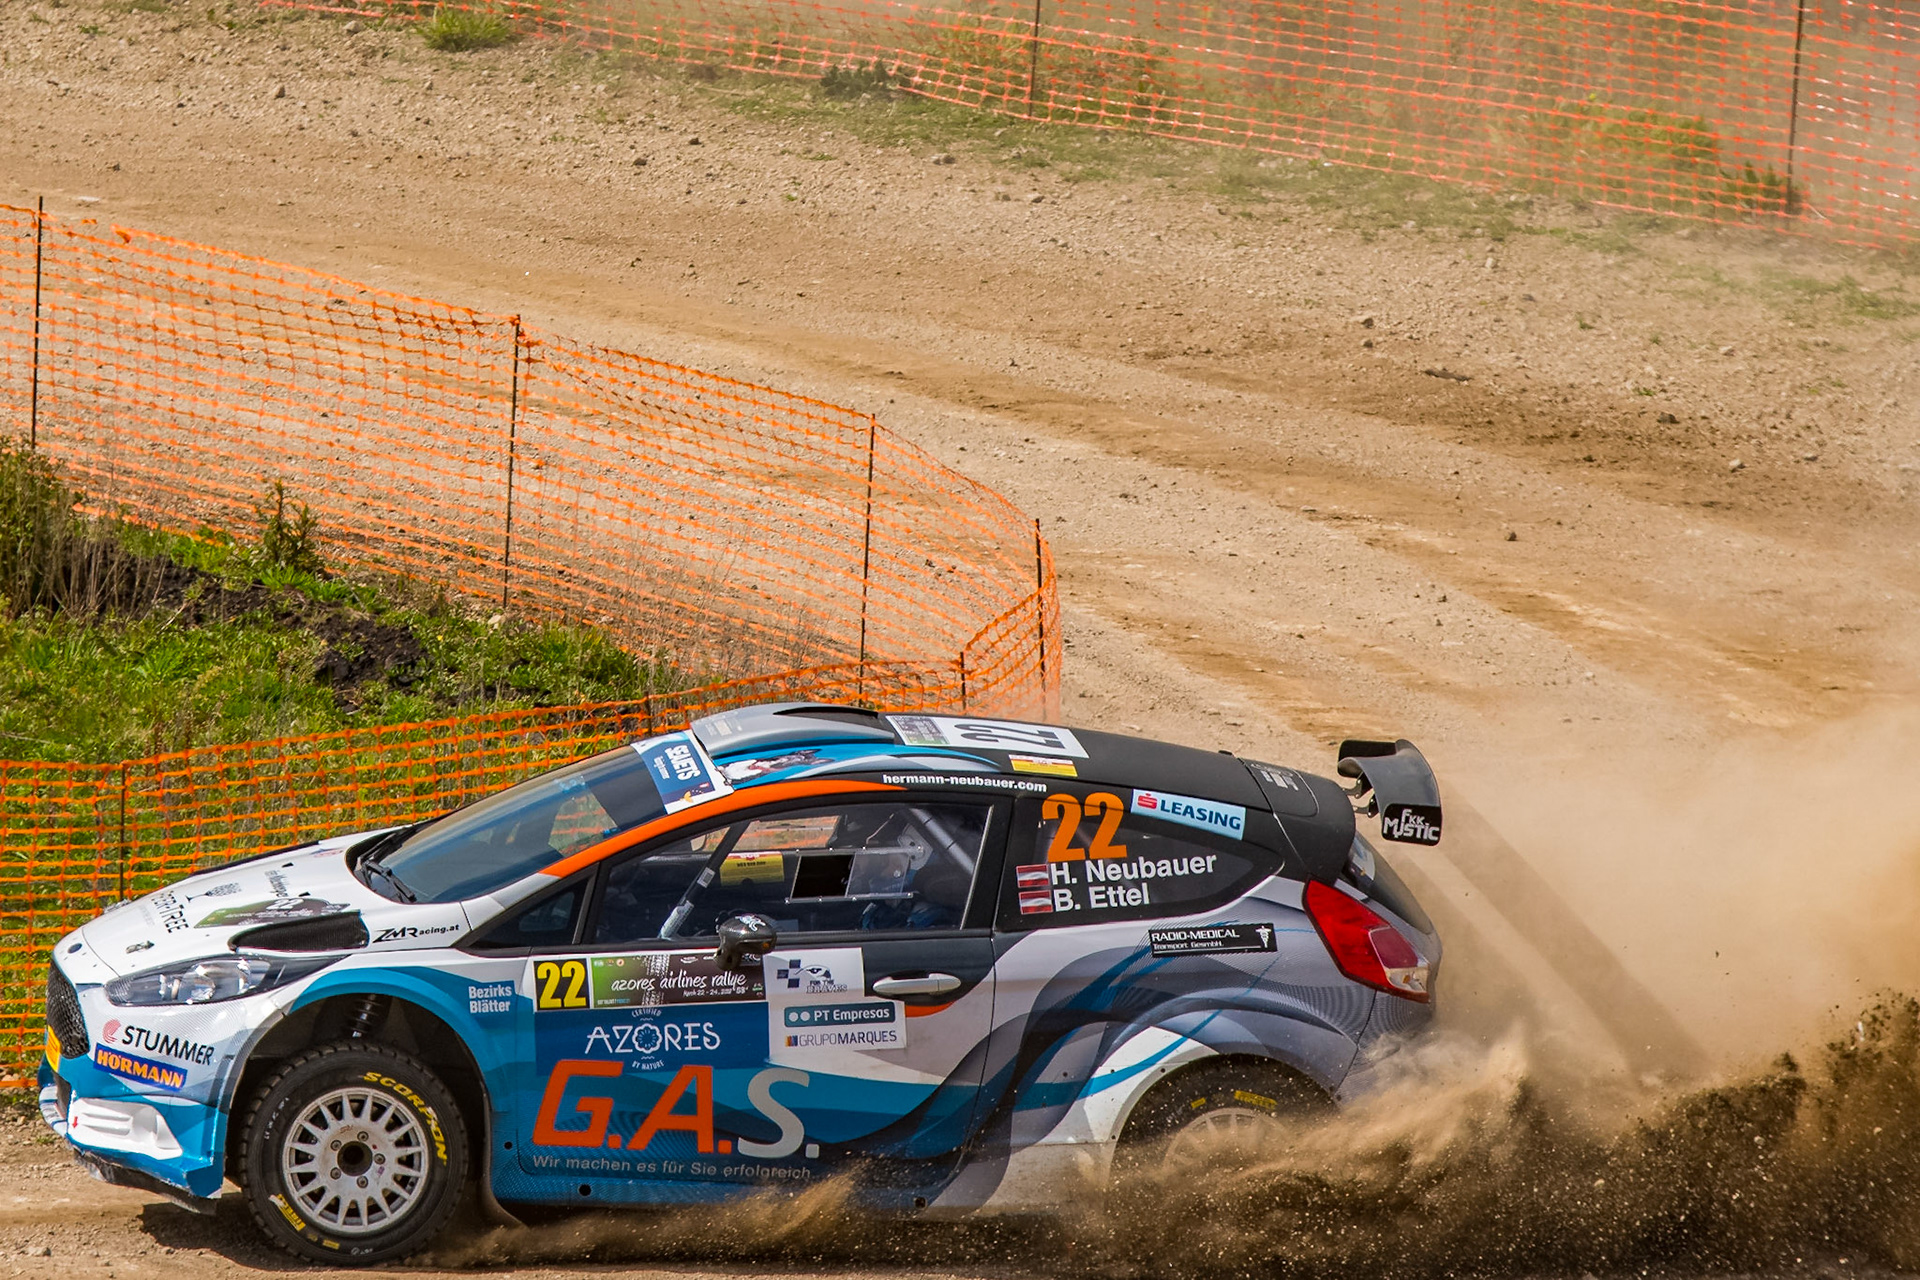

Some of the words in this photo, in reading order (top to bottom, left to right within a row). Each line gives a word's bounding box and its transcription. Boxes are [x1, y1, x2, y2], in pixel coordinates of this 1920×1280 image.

[882, 774, 1047, 792] hermann-neubauer.com
[1041, 792, 1128, 863] 22
[1160, 799, 1242, 830] LEASING
[1051, 862, 1077, 885] H.
[1085, 854, 1217, 883] Neubauer
[1053, 889, 1081, 912] B.
[1088, 882, 1150, 909] Ettel
[1151, 929, 1240, 942] RADIO-MEDICAL
[1153, 942, 1188, 950] Transport
[468, 985, 512, 999] Bezirks
[536, 960, 587, 1009] 22
[611, 976, 655, 991] azores
[660, 970, 706, 990] airlines
[711, 970, 747, 992] rallye
[469, 1000, 511, 1014] Blätter
[813, 1010, 830, 1022] PT
[833, 1008, 890, 1022] Empresas
[122, 1025, 215, 1066] STUMMER
[584, 1022, 721, 1054] AZORES
[96, 1048, 184, 1088] HÖRMANN
[641, 1060, 664, 1070] NATURE
[363, 1071, 448, 1165] SCORPION
[532, 1059, 820, 1159] G.A.S.
[532, 1155, 560, 1168] Wir
[566, 1157, 631, 1172] machen
[637, 1162, 656, 1173] es
[662, 1160, 684, 1175] für
[691, 1162, 716, 1176] Sie
